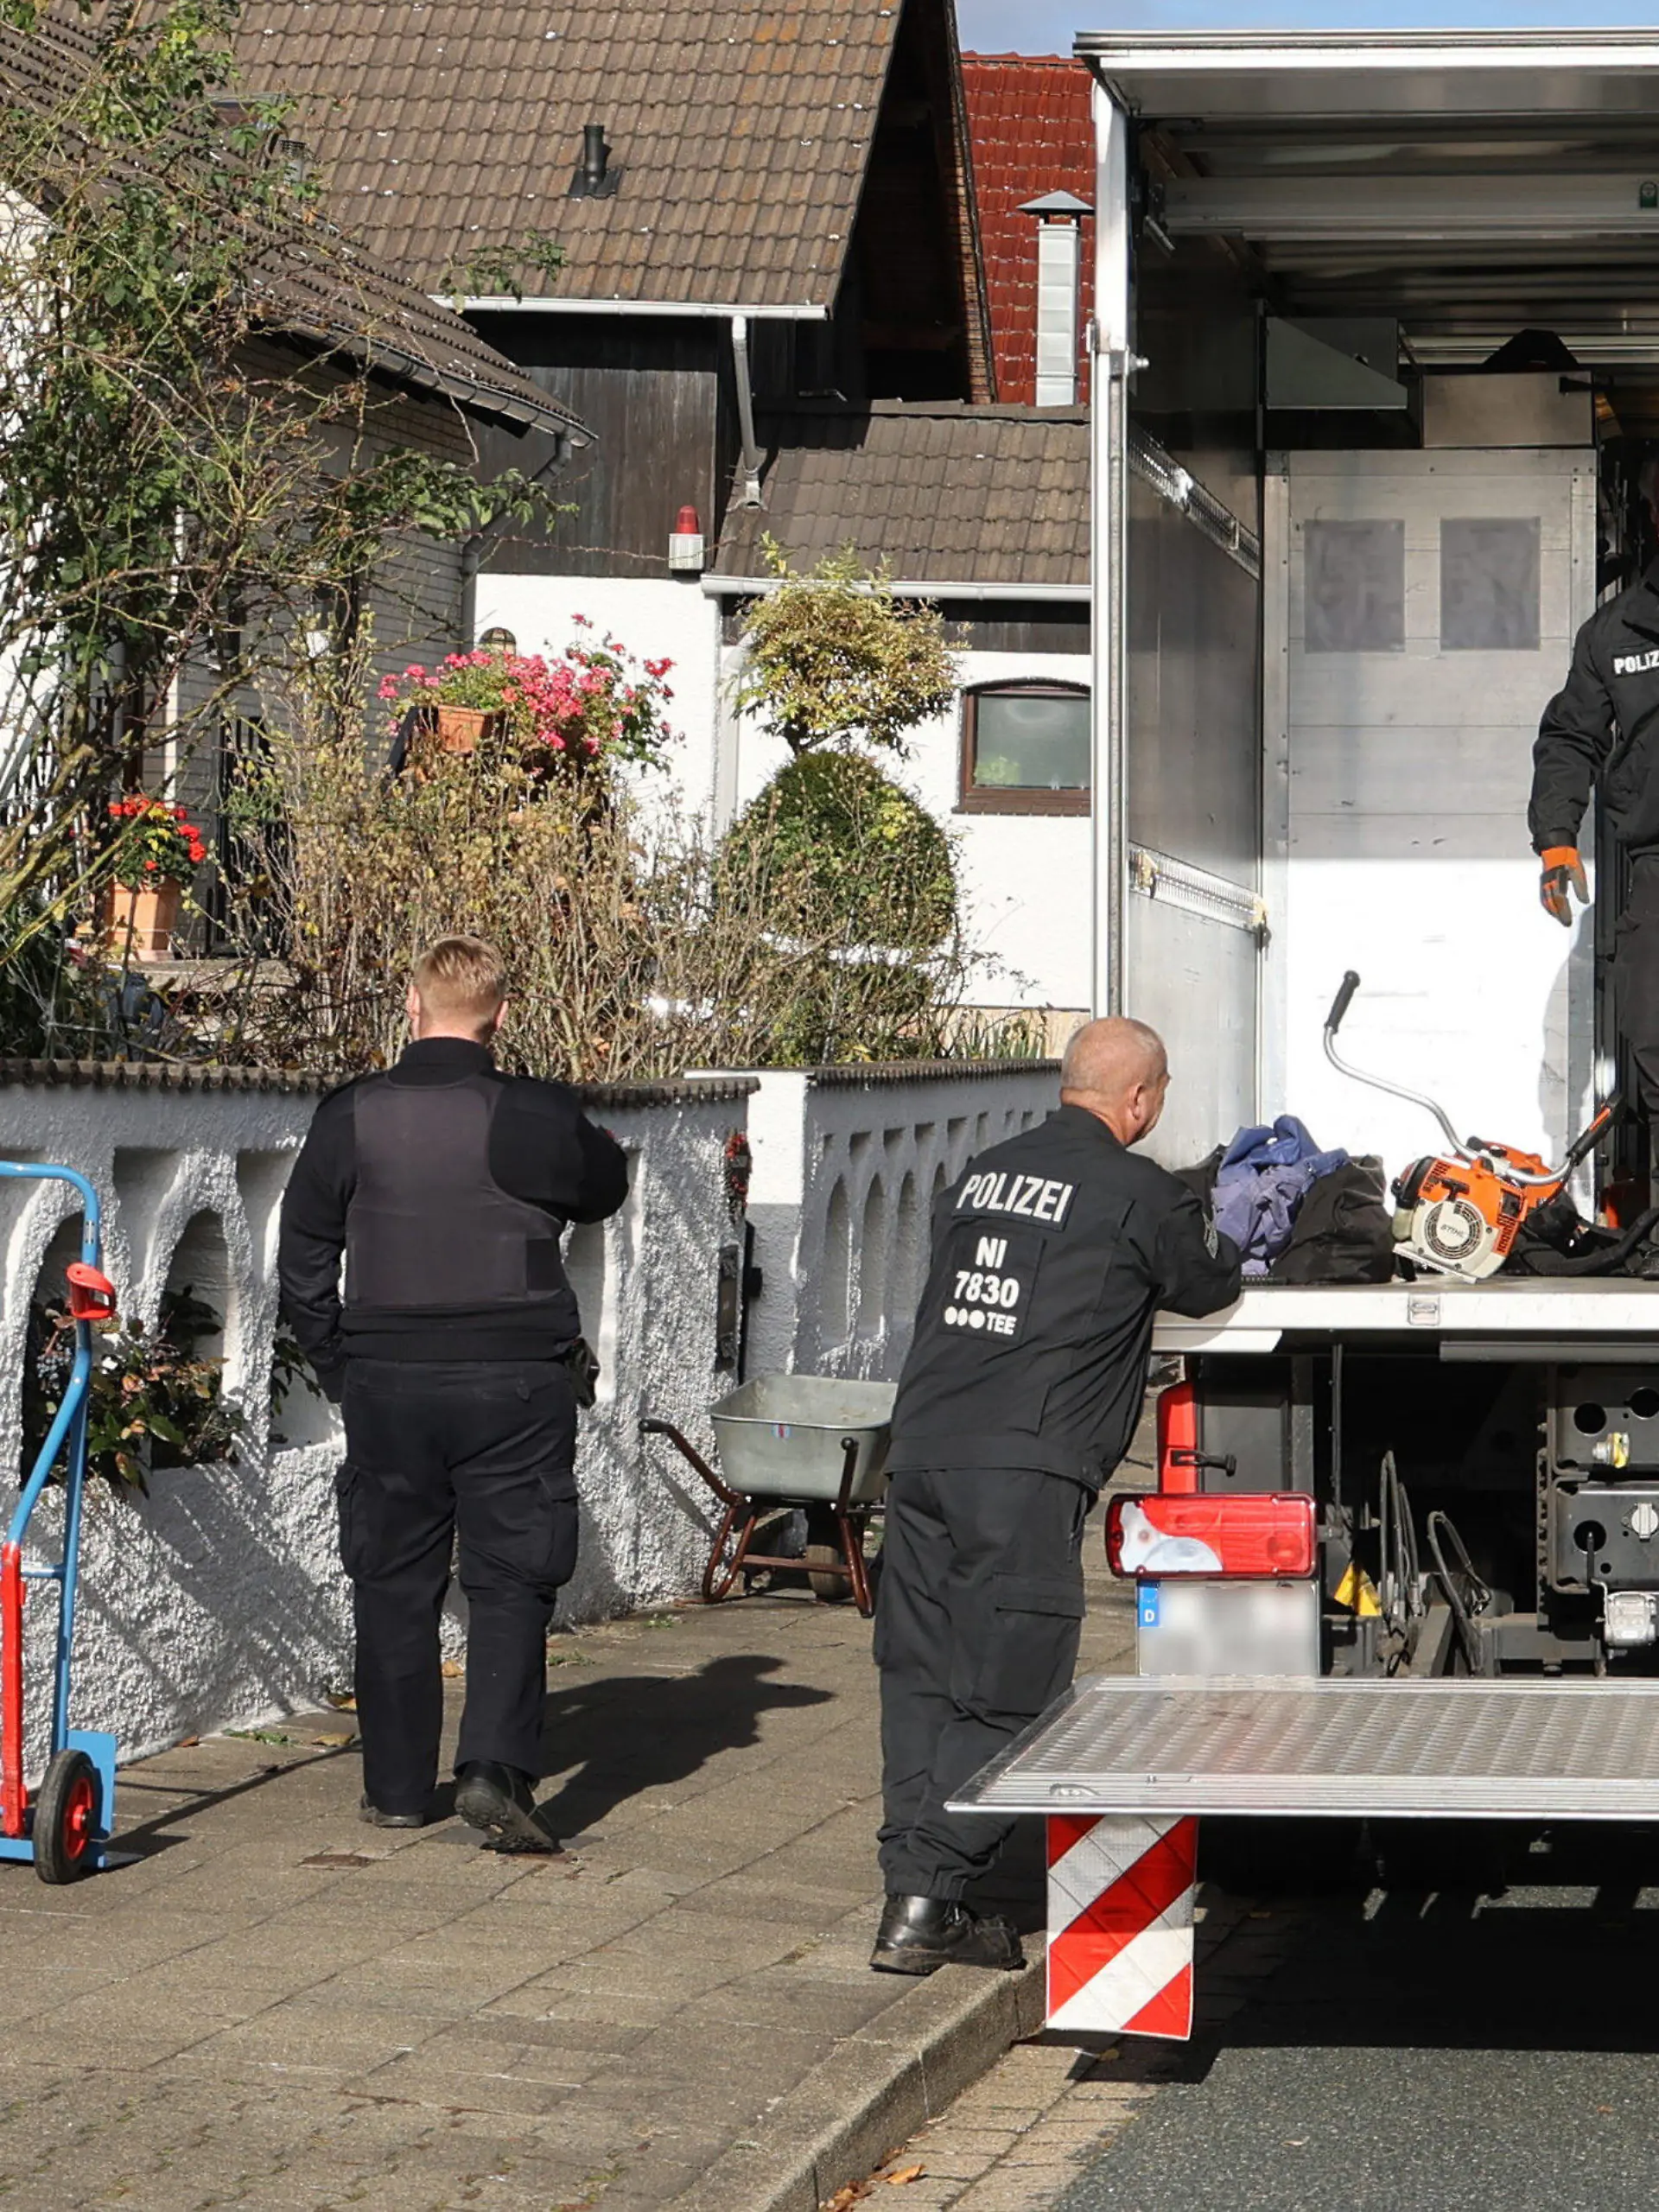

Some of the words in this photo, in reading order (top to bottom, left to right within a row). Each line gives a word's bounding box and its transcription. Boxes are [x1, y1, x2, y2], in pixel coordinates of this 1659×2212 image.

[956, 1173, 1074, 1223] POLIZEI
[975, 1236, 1008, 1269] NI
[954, 1270, 1020, 1308] 7830
[1144, 1609, 1155, 1623] D
